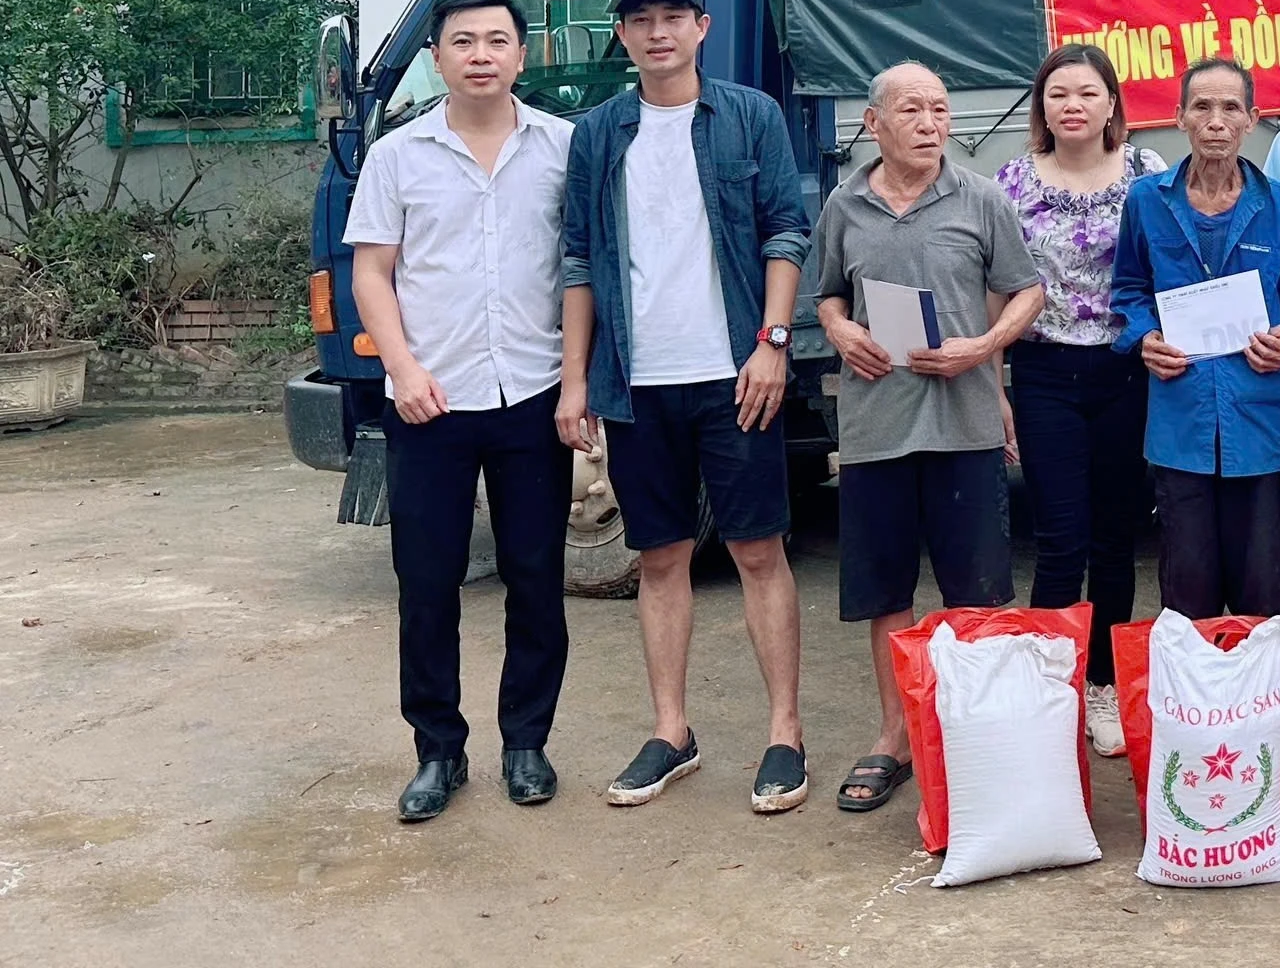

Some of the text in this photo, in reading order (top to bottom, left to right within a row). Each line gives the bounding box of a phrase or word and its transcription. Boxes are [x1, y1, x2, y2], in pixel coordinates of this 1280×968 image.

[1062, 20, 1175, 84] ỚNG
[1179, 2, 1222, 68] VỀ
[1203, 824, 1277, 868] HƯƠNG
[1251, 856, 1277, 876] 10KG
